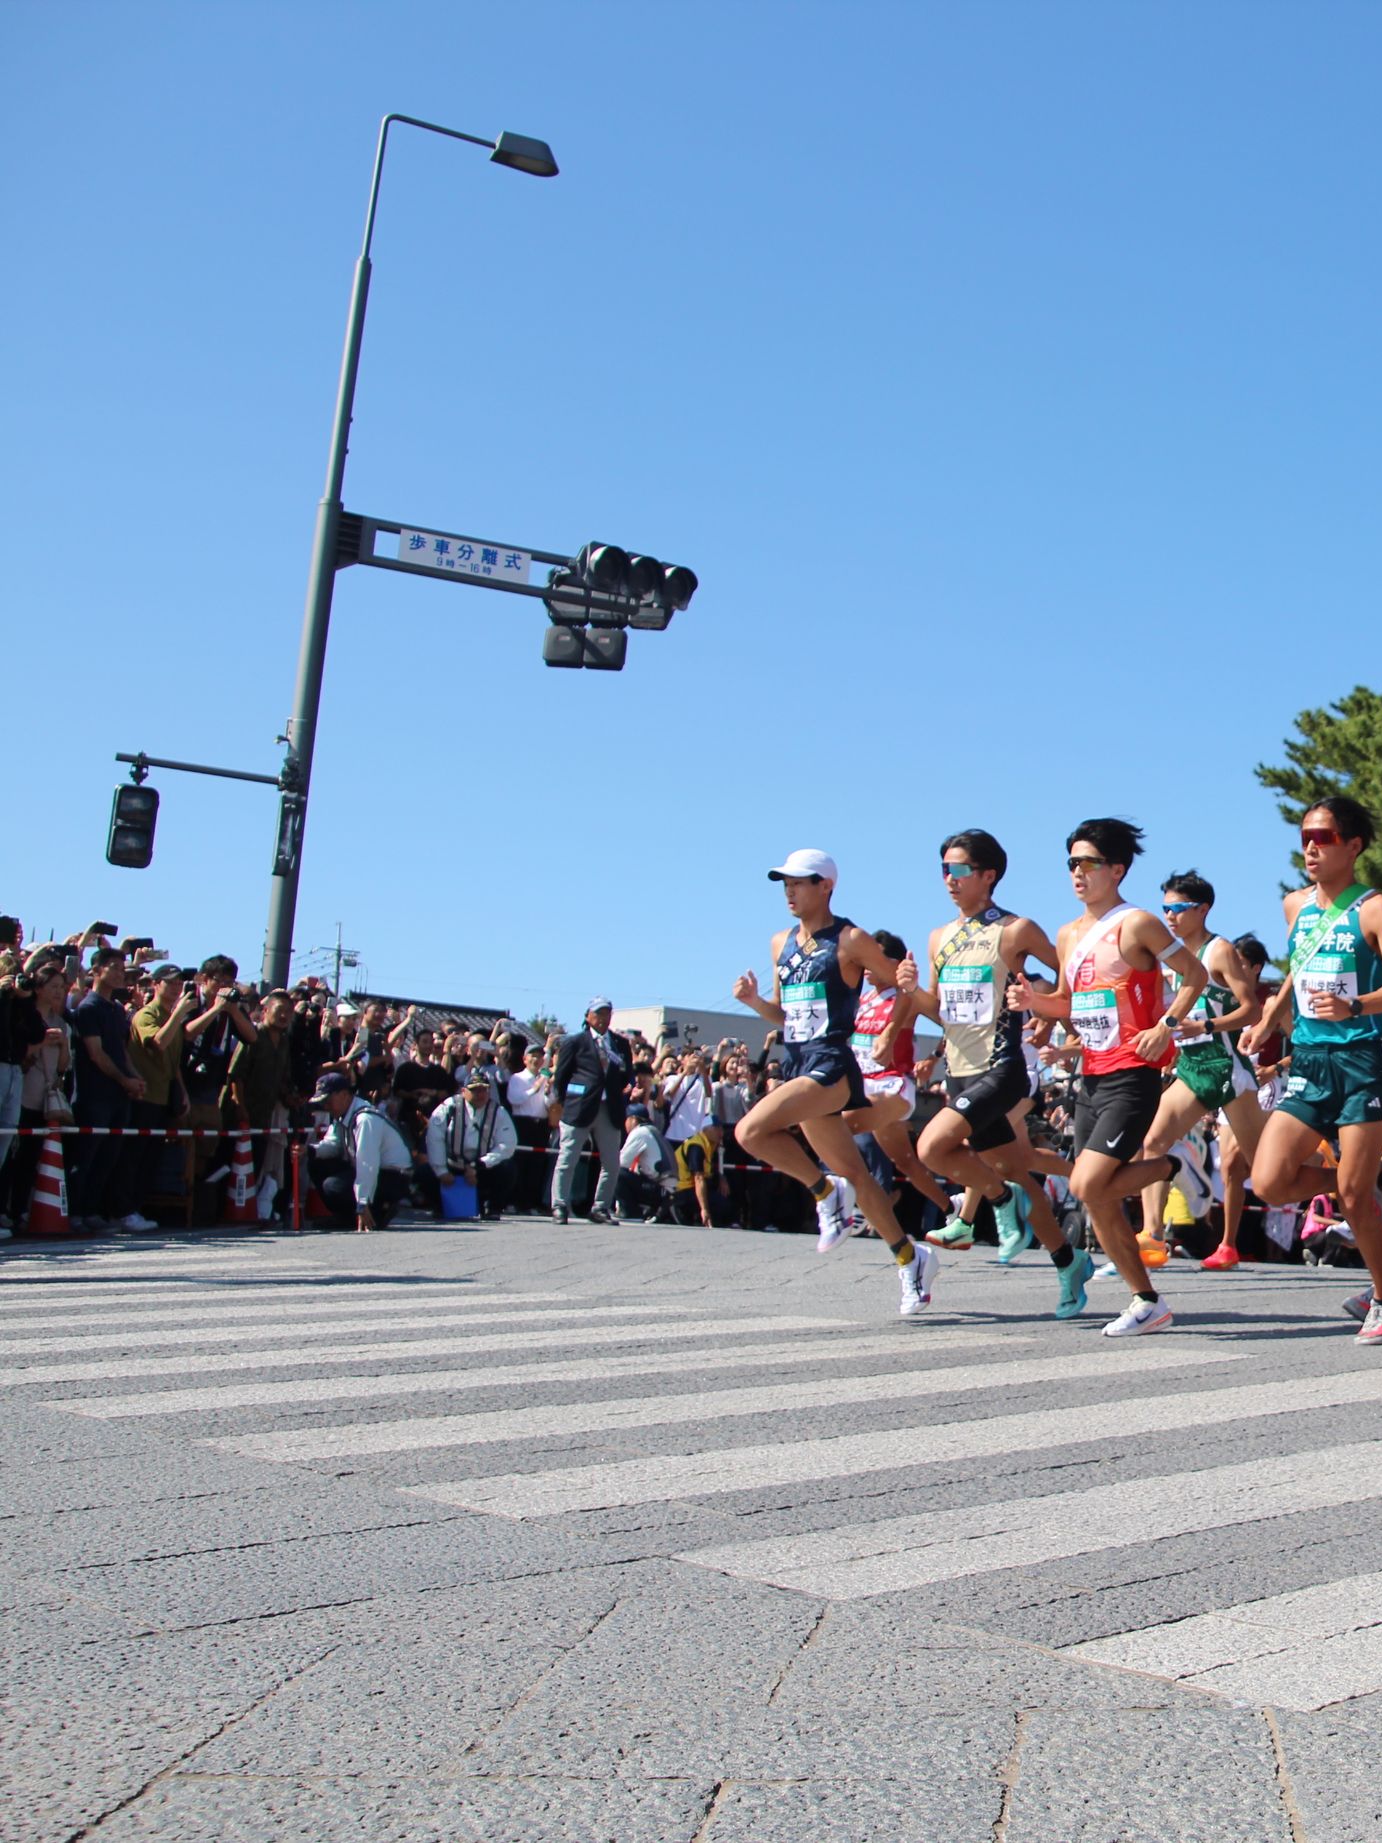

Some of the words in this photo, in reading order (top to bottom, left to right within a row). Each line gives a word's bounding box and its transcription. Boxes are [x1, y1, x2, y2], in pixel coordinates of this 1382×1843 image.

[409, 534, 522, 570] 歩車分離式
[1293, 930, 1355, 952] 青学院
